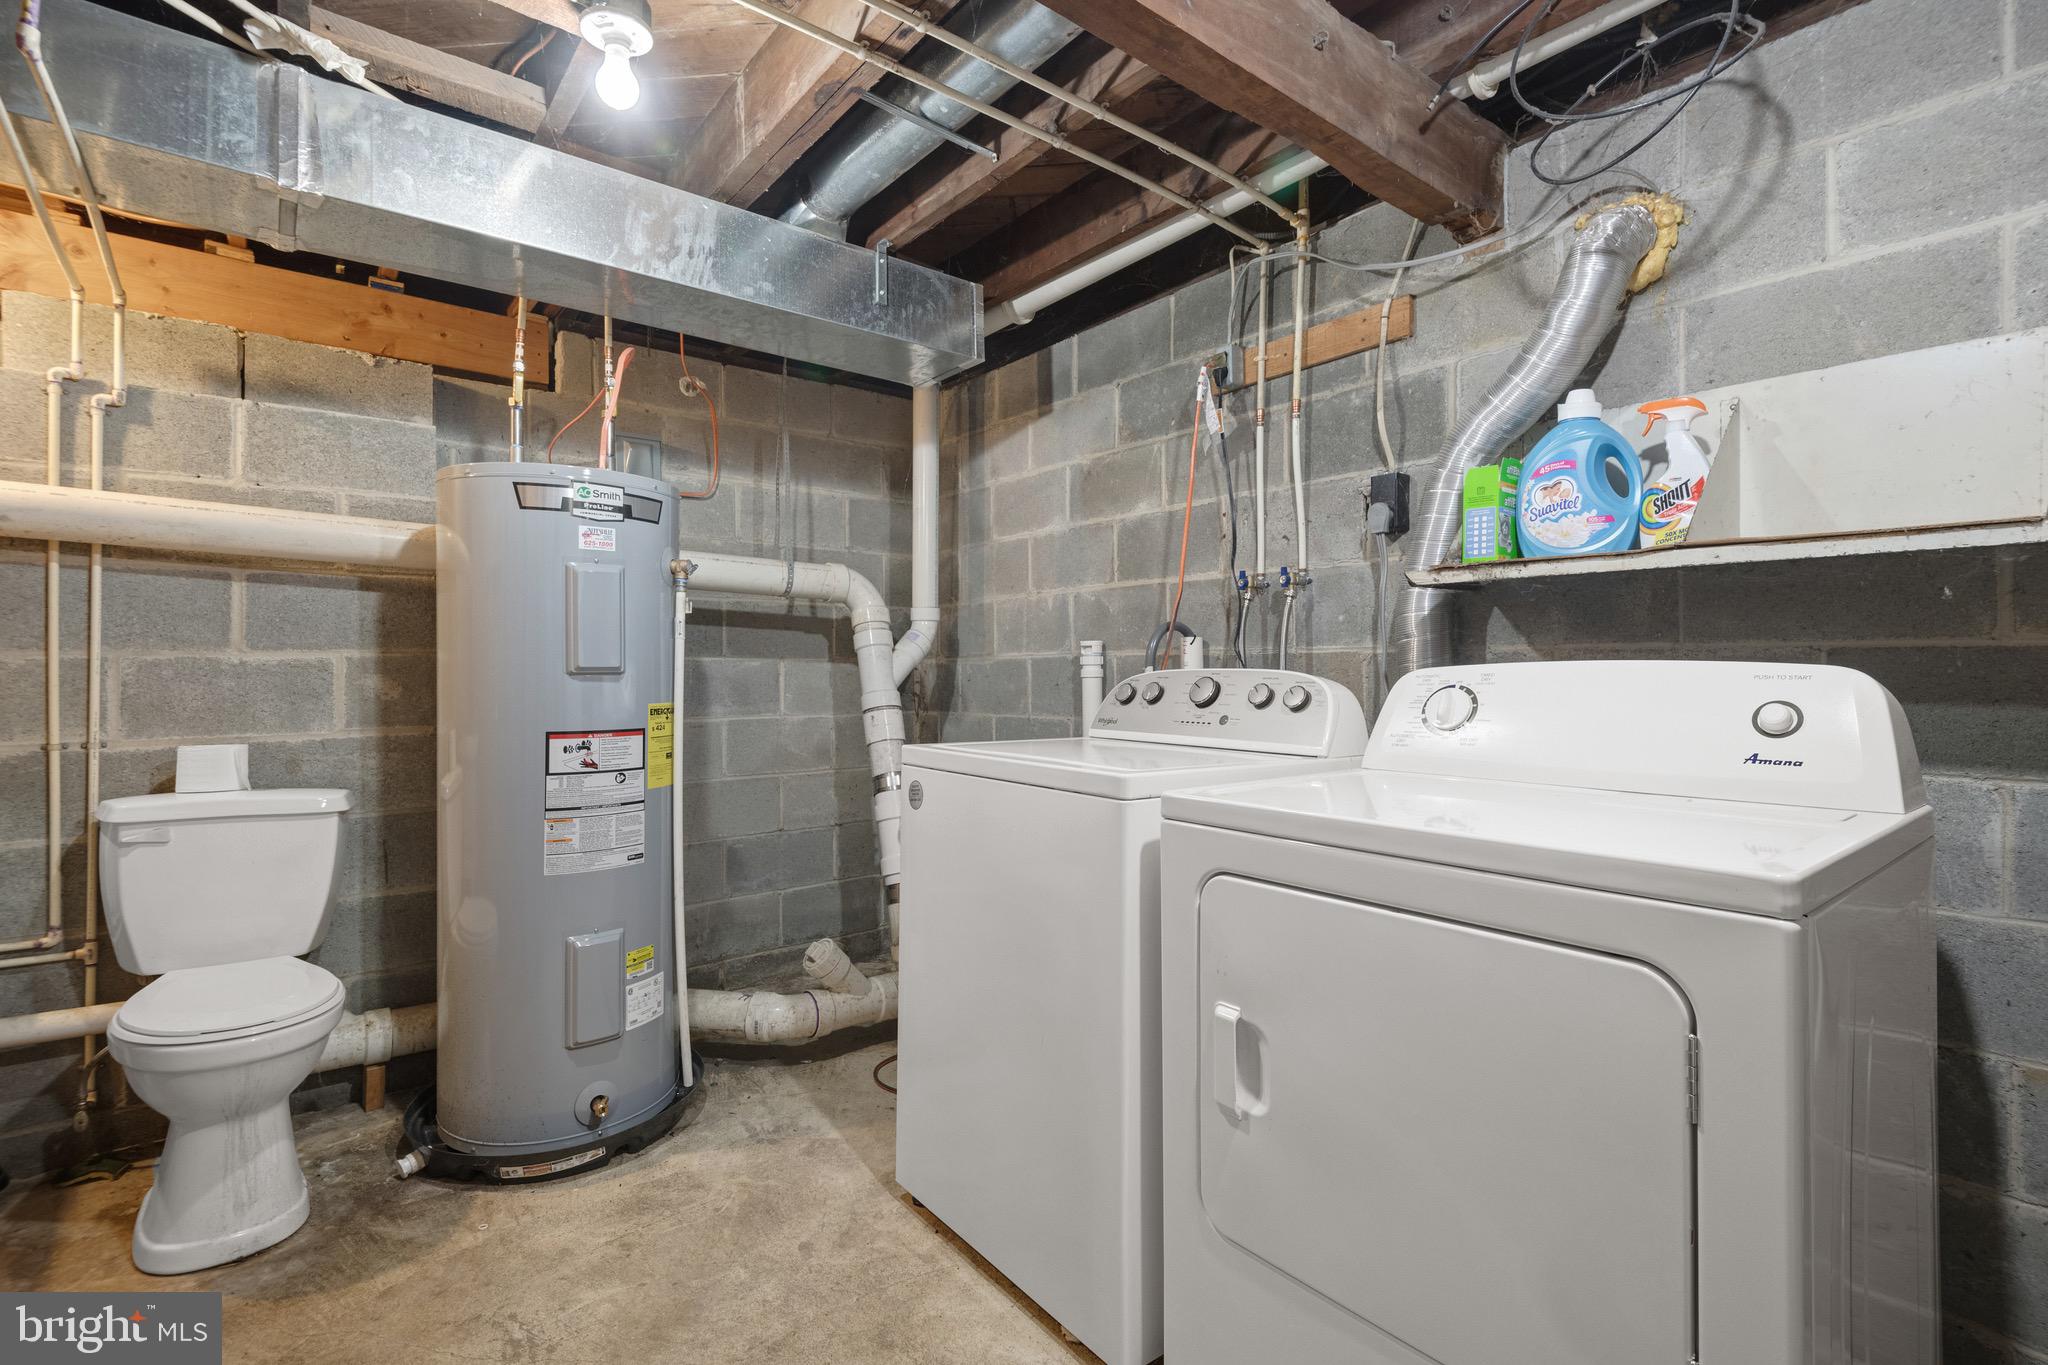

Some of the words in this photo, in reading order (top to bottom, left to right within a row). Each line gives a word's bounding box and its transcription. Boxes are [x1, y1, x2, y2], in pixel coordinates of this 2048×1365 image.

[1539, 464, 1551, 474] 45
[592, 489, 621, 502] Smith
[1653, 478, 1691, 515] SHOUT
[1529, 496, 1580, 522] Suavitel
[1664, 529, 1678, 538] 50X
[1743, 752, 1804, 767] Amana
